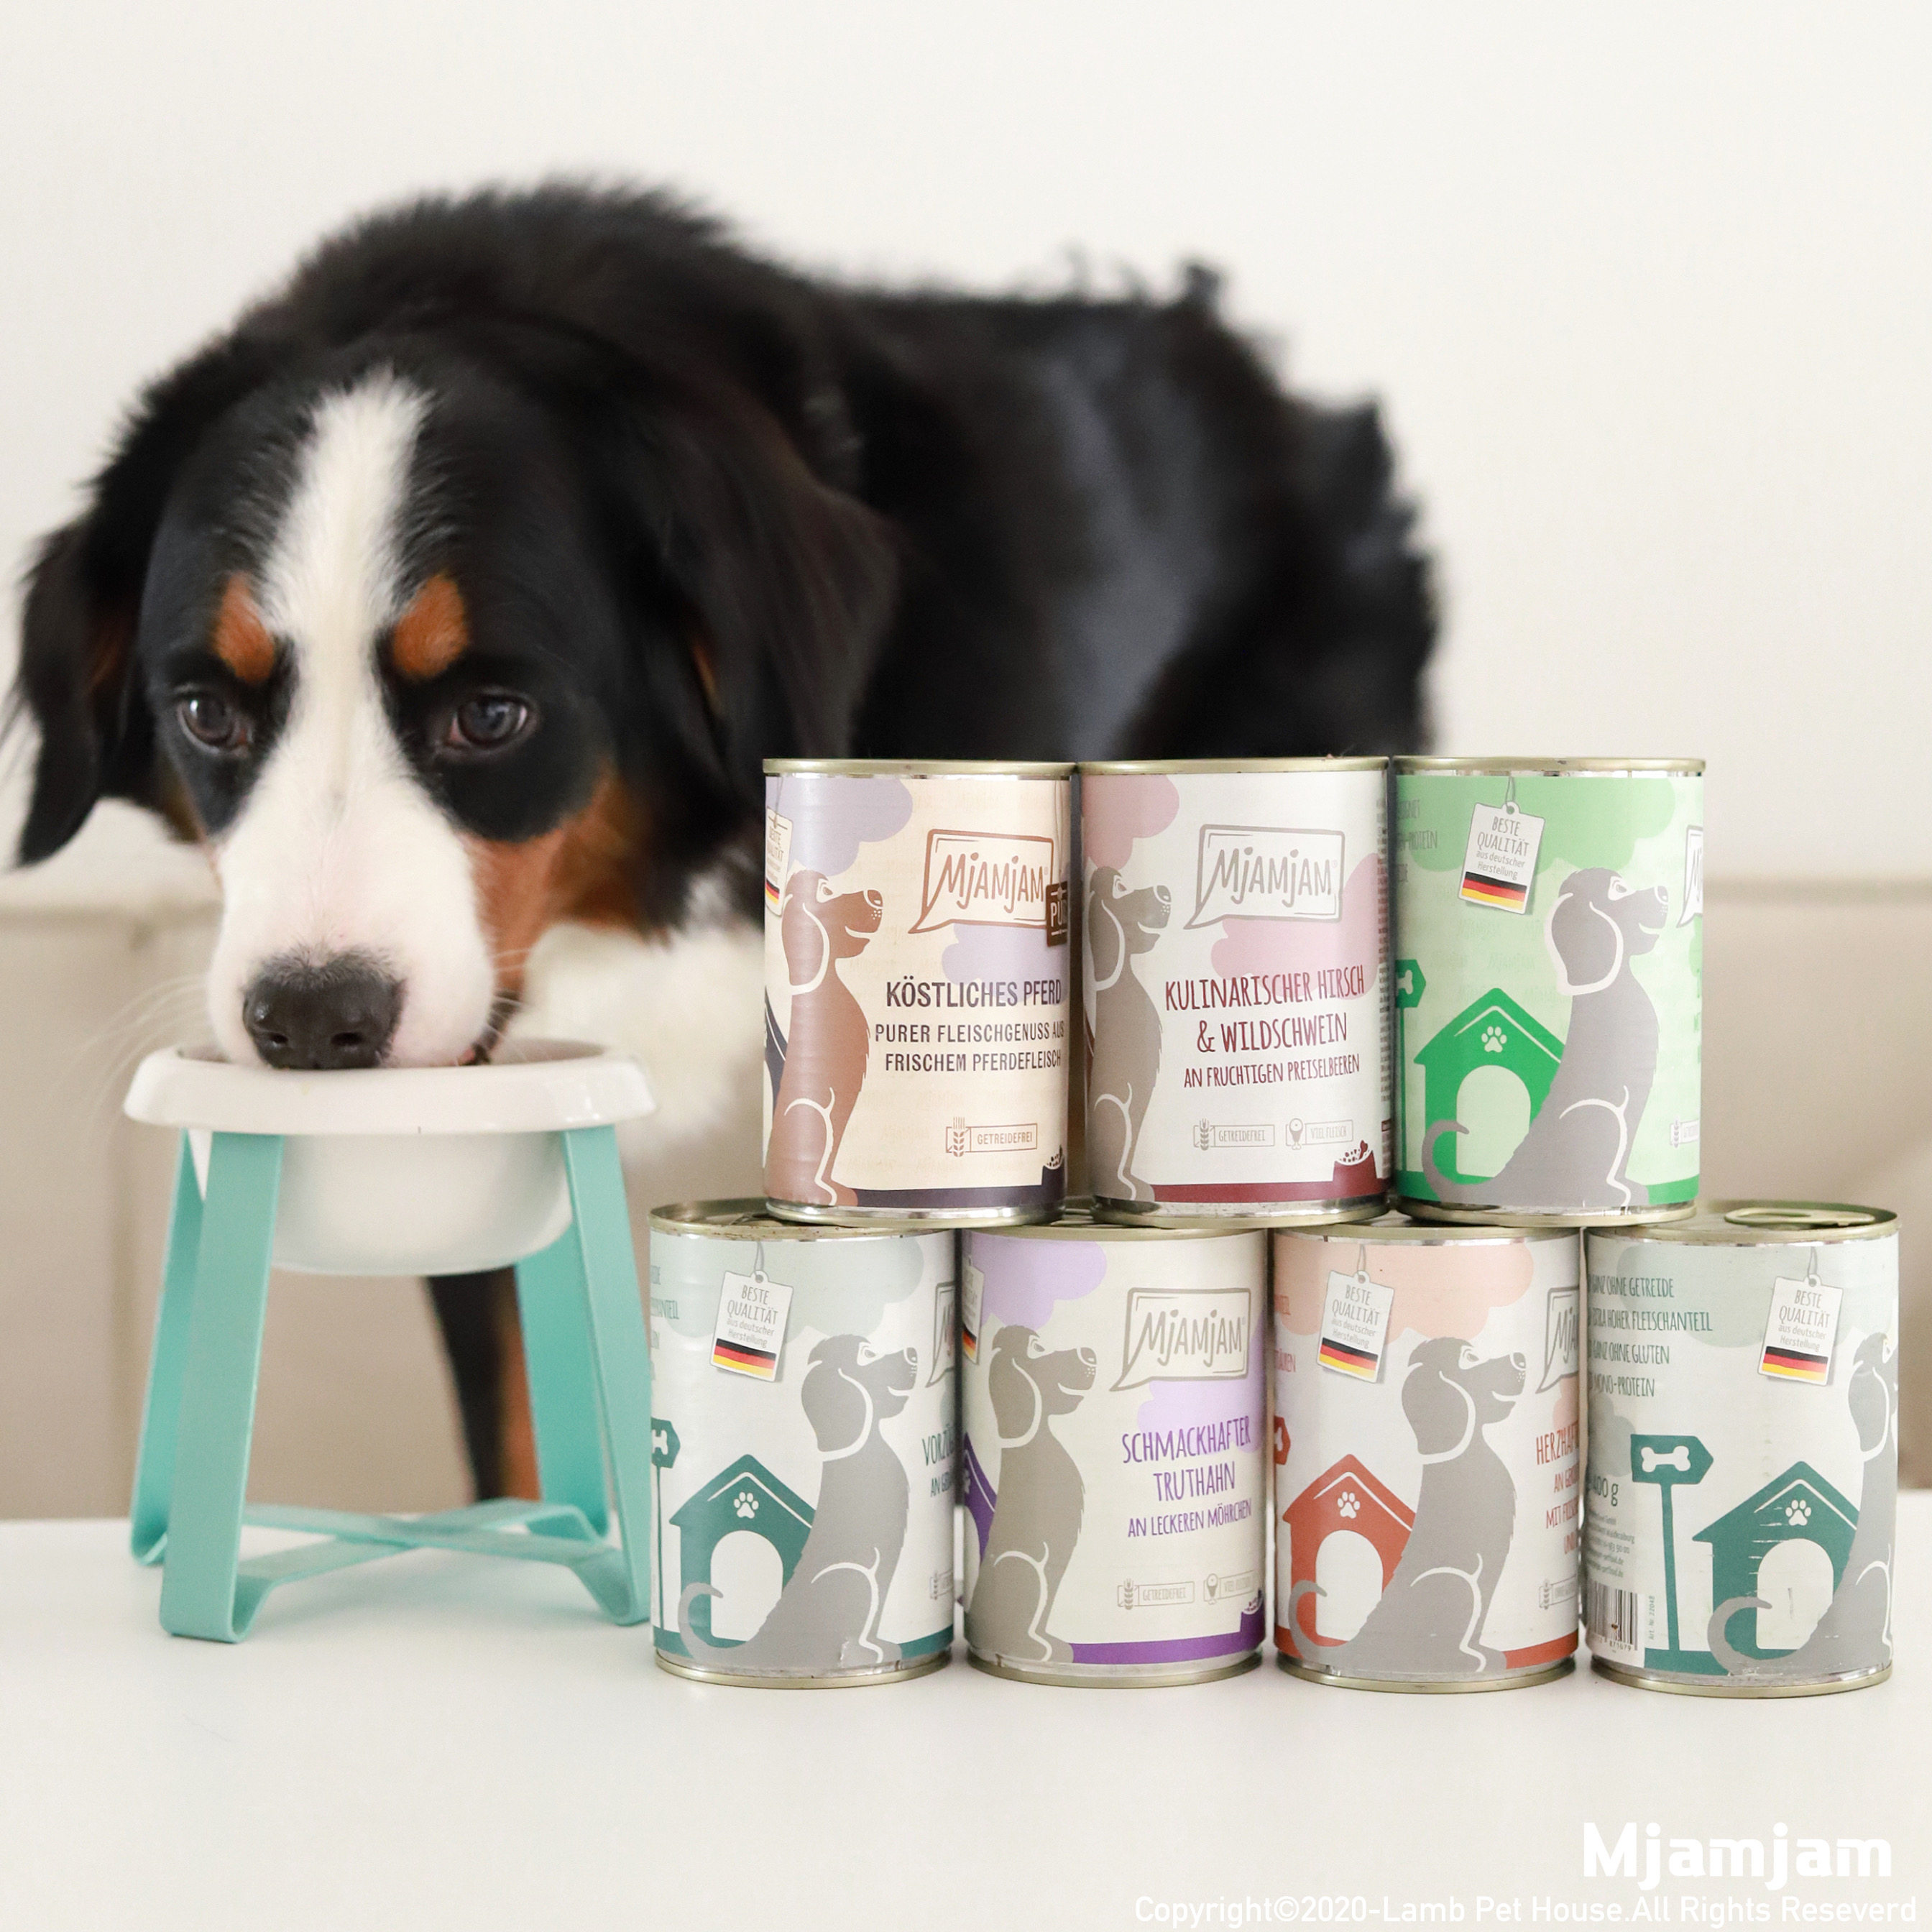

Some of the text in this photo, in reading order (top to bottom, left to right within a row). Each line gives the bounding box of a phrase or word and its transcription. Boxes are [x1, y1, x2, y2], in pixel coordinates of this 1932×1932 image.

[1491, 816, 1521, 837] BESTE
[1477, 832, 1530, 857] QUALITÄT
[886, 975, 1062, 1008] KÖSTLICHES PFERD
[1165, 964, 1364, 1011] KULINARISCHER HIRSCH
[875, 1024, 931, 1043] PURER
[937, 1021, 1050, 1043] FLEISCHGENUSS
[1197, 1011, 1348, 1053] & WILDSCHWEIN
[885, 1049, 1062, 1072] FRISCHEM PFERDEFLEISCH
[1184, 1053, 1360, 1088] AN FRUCHTIGEN PREISELBEEREN
[977, 1131, 1033, 1146] GETREIDEFREI
[1218, 1128, 1266, 1143] GETREIDEFREI
[741, 1284, 770, 1305] BESTE
[1345, 1284, 1372, 1306] BESTE
[1607, 1276, 1627, 1297] OHNE
[1629, 1277, 1675, 1298] GETREIDE
[1794, 1289, 1823, 1309] BESTE
[727, 1299, 778, 1325] QUALITÄT
[1332, 1299, 1381, 1326] QUALITÄT
[1607, 1309, 1631, 1330] HOHER
[1632, 1311, 1713, 1331] FLEISCHANTEIL
[1778, 1305, 1831, 1328] QUALITÄT
[1609, 1342, 1631, 1363] OHNE
[1632, 1344, 1670, 1365] GLUTEN
[1121, 1415, 1251, 1463] SCHMACKHAFTER
[1153, 1460, 1236, 1501] TRUTHAHN
[1128, 1498, 1252, 1538] AN LECKEREN MÖHRCHEN
[1546, 1505, 1562, 1529] MIT
